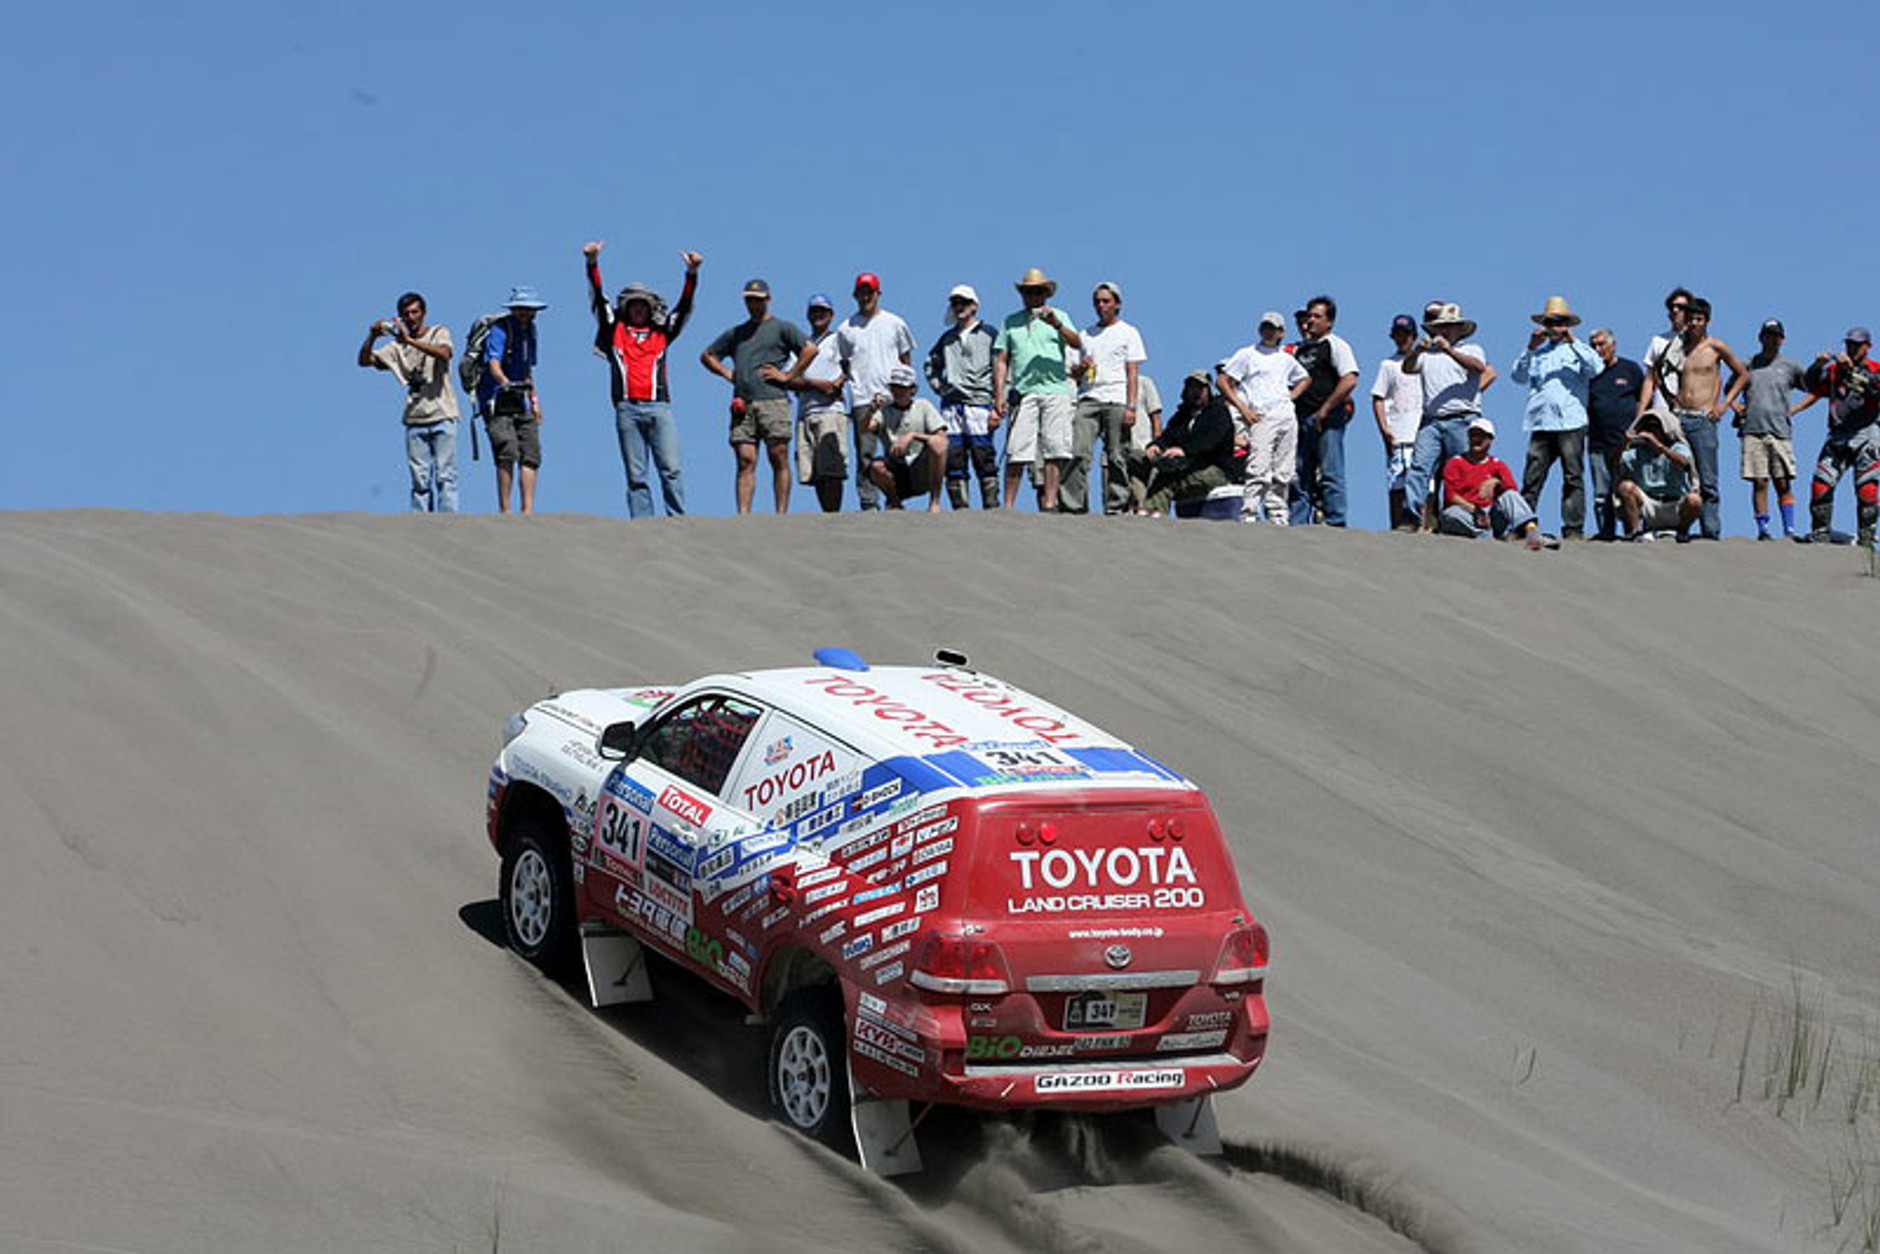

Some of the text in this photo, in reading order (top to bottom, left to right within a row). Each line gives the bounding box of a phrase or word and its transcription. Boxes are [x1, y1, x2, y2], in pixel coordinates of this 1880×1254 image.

[804, 674, 970, 749] TOYOTA
[921, 672, 1081, 744] TOYOTA
[985, 751, 1064, 765] 341
[743, 750, 836, 812] TOYOTA
[666, 790, 704, 826] TOTAL
[602, 802, 641, 861] 341
[1009, 846, 1196, 889] TOYOTA
[1008, 887, 1205, 914] LAND CRUISER 200
[1090, 1003, 1116, 1019] 341
[1037, 1071, 1183, 1089] GAZOO Racing
